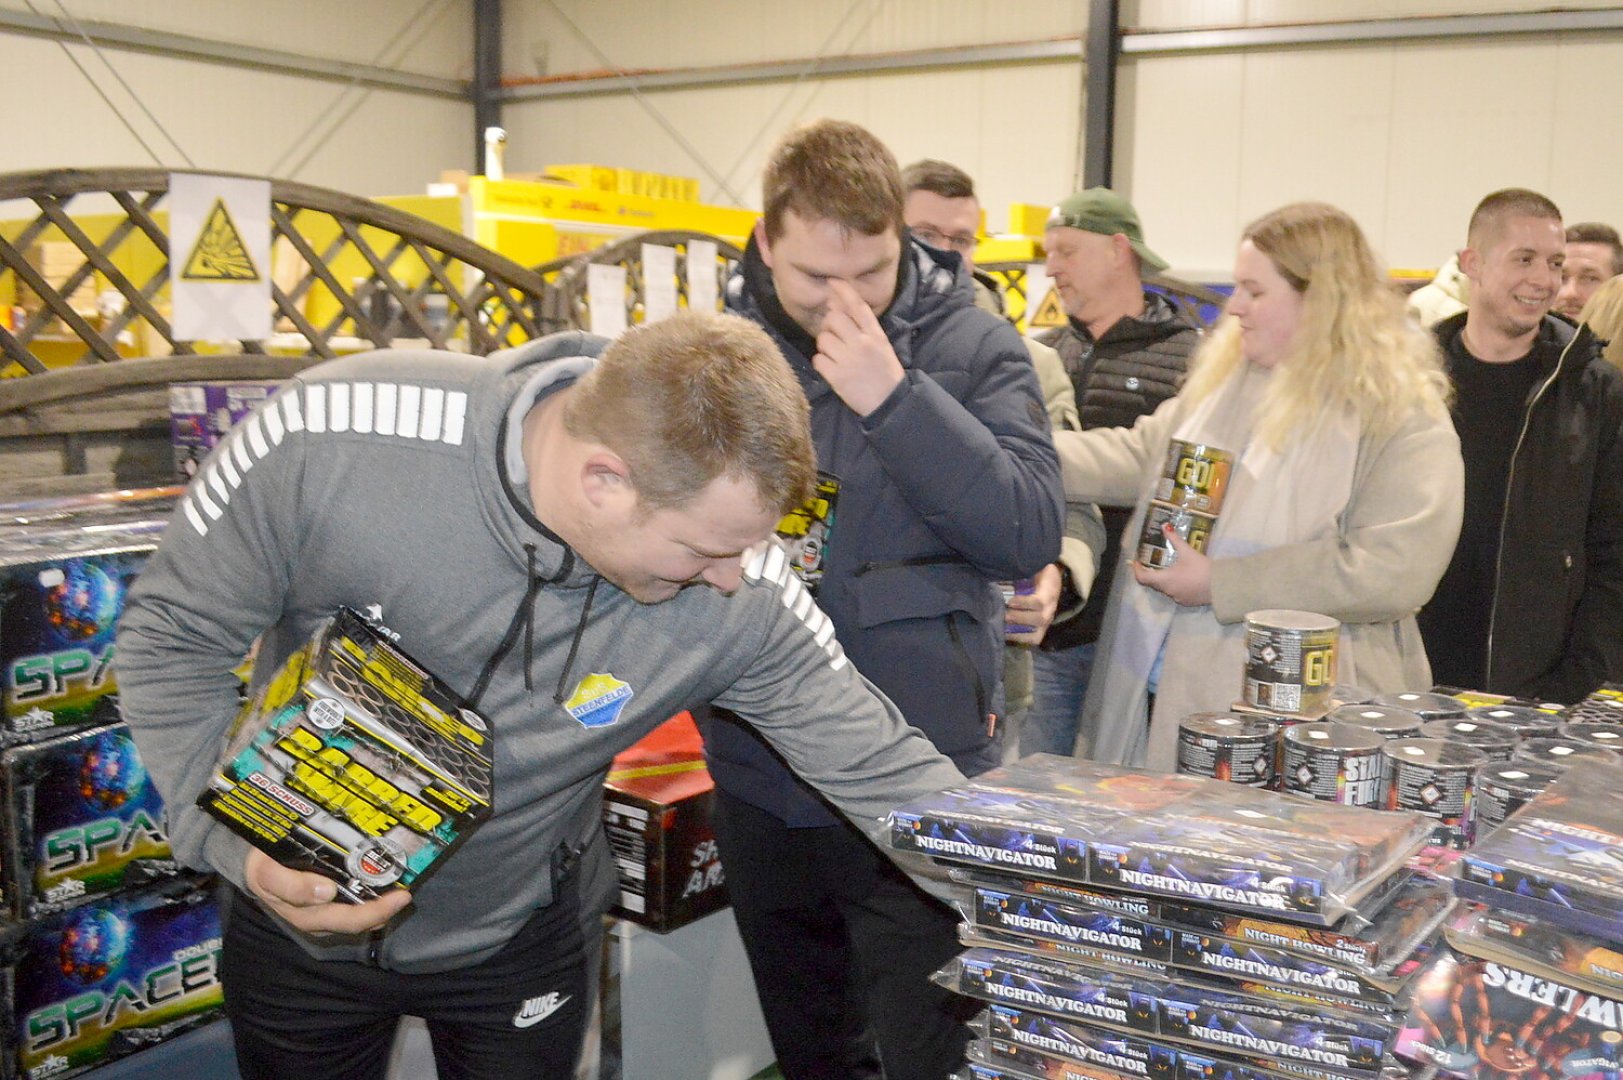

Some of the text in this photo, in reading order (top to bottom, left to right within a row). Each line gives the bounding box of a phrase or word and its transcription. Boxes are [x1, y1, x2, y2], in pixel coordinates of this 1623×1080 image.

[250, 774, 269, 788] 36
[267, 784, 314, 816] SCHUSS
[285, 760, 400, 837] WIRE
[45, 811, 169, 875] SPA
[915, 835, 1057, 870] NIGHTNAVIGATOR
[1026, 839, 1034, 850] 4
[1119, 868, 1288, 909] NIGHTNAVIGATOR
[1250, 876, 1260, 887] 4
[1084, 895, 1150, 914] HOWLING
[1000, 912, 1142, 951] NIGHTNAVIGATOR
[1112, 919, 1143, 936] 4 Stück
[1244, 927, 1366, 965] NIGHT HOWLING
[1201, 951, 1361, 995] NIGHTNAVIGATOR
[27, 949, 223, 1054] SPACE
[520, 991, 560, 1018] NIKE
[985, 981, 1128, 1023] NIGHTNAVIGATOR
[1096, 992, 1106, 1002] 4
[1482, 962, 1623, 1029] WLERS
[1012, 1027, 1149, 1074] NIGHTNAVIGATOR
[1188, 1024, 1349, 1067] NIGHTNAVIGATOR
[1315, 1036, 1324, 1046] 4
